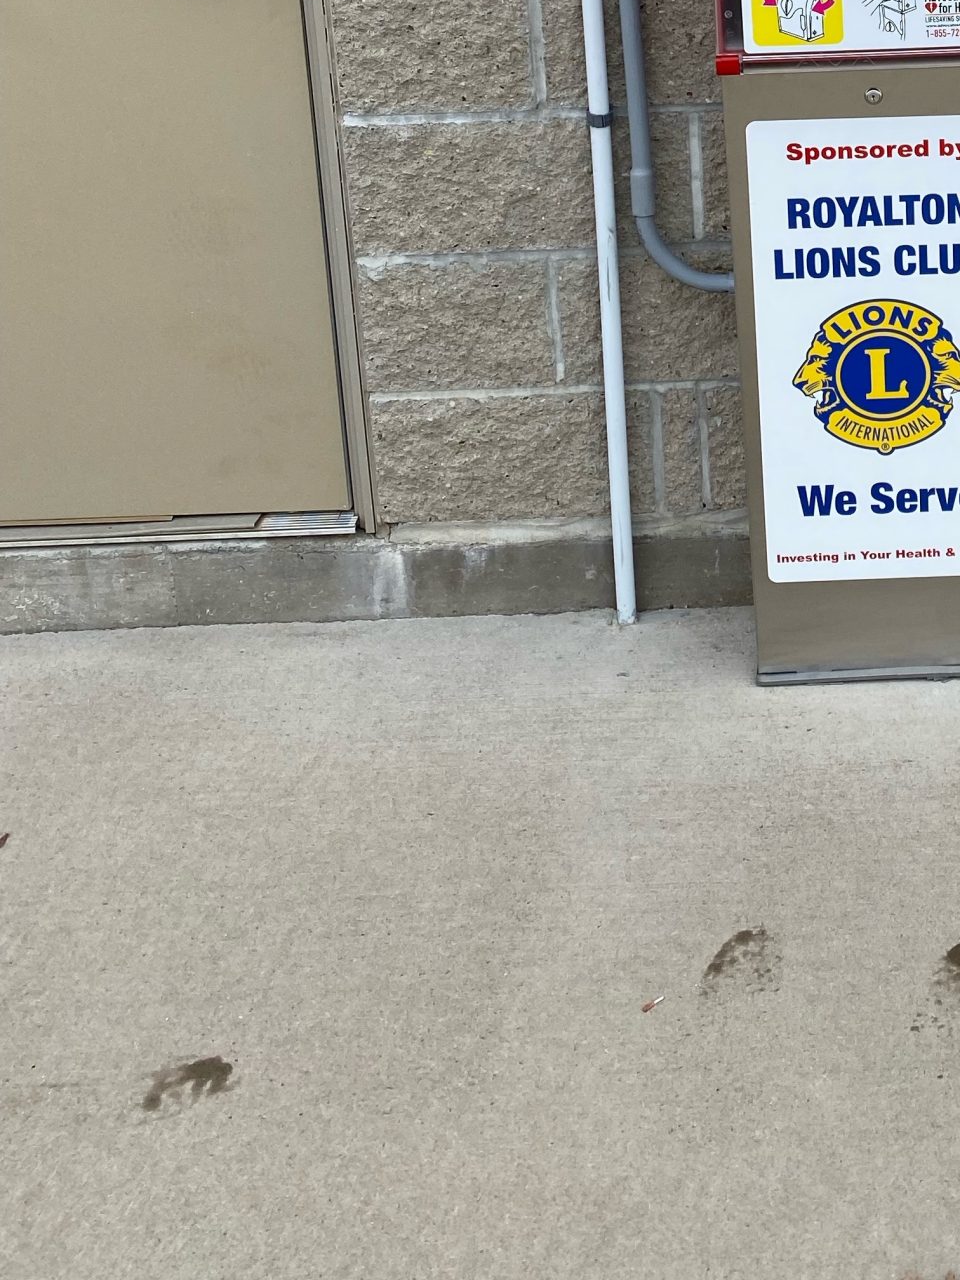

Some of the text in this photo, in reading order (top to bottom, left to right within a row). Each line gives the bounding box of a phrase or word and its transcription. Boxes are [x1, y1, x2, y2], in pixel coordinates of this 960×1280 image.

[939, 3, 952, 13] for
[787, 139, 929, 164] Sponsored
[774, 246, 881, 279] LIONS
[830, 306, 933, 339] LIONS
[865, 349, 909, 400] L
[835, 414, 935, 441] INTERNATIONAL
[797, 485, 857, 516] We
[777, 553, 839, 563] Investing
[844, 552, 855, 560] in
[861, 551, 890, 560] Your
[896, 548, 940, 558] Health
[946, 548, 955, 557] &
